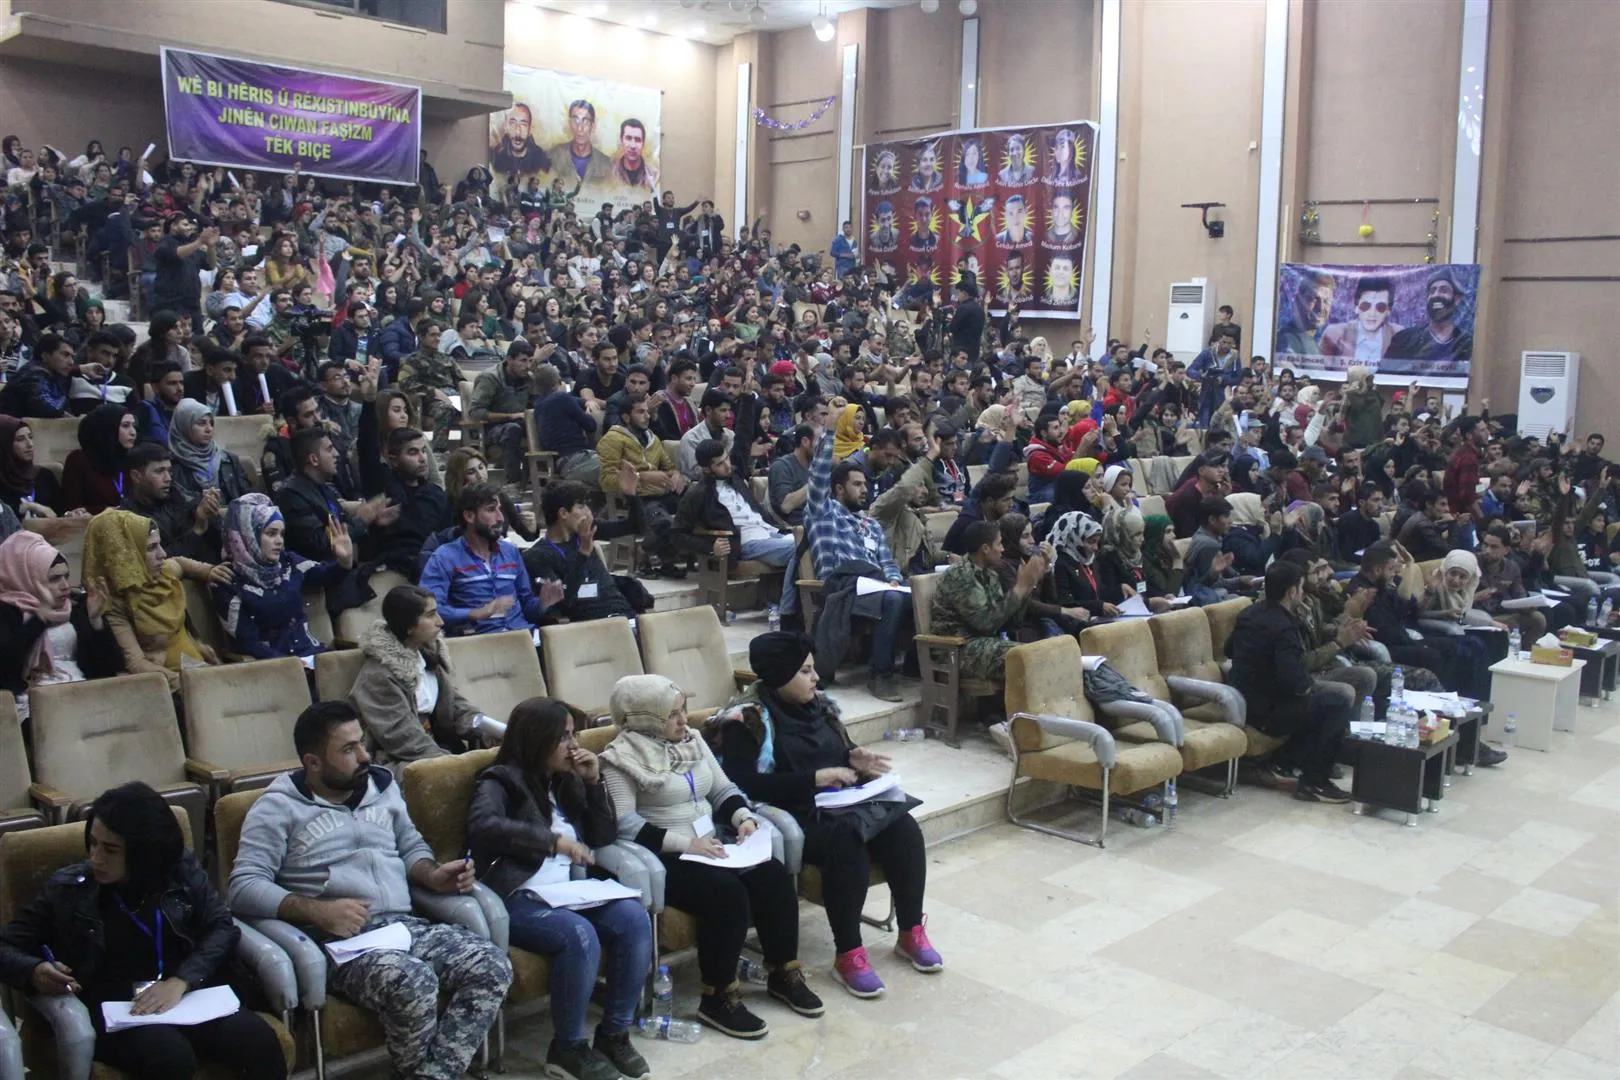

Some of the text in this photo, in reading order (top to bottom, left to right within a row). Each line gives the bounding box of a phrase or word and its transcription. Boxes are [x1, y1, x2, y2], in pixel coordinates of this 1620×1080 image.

[207, 80, 223, 97] BI
[228, 81, 273, 105] HÊRIS
[218, 107, 265, 127] JINÊN
[269, 113, 318, 134] CIWAN
[264, 132, 294, 155] TÊK
